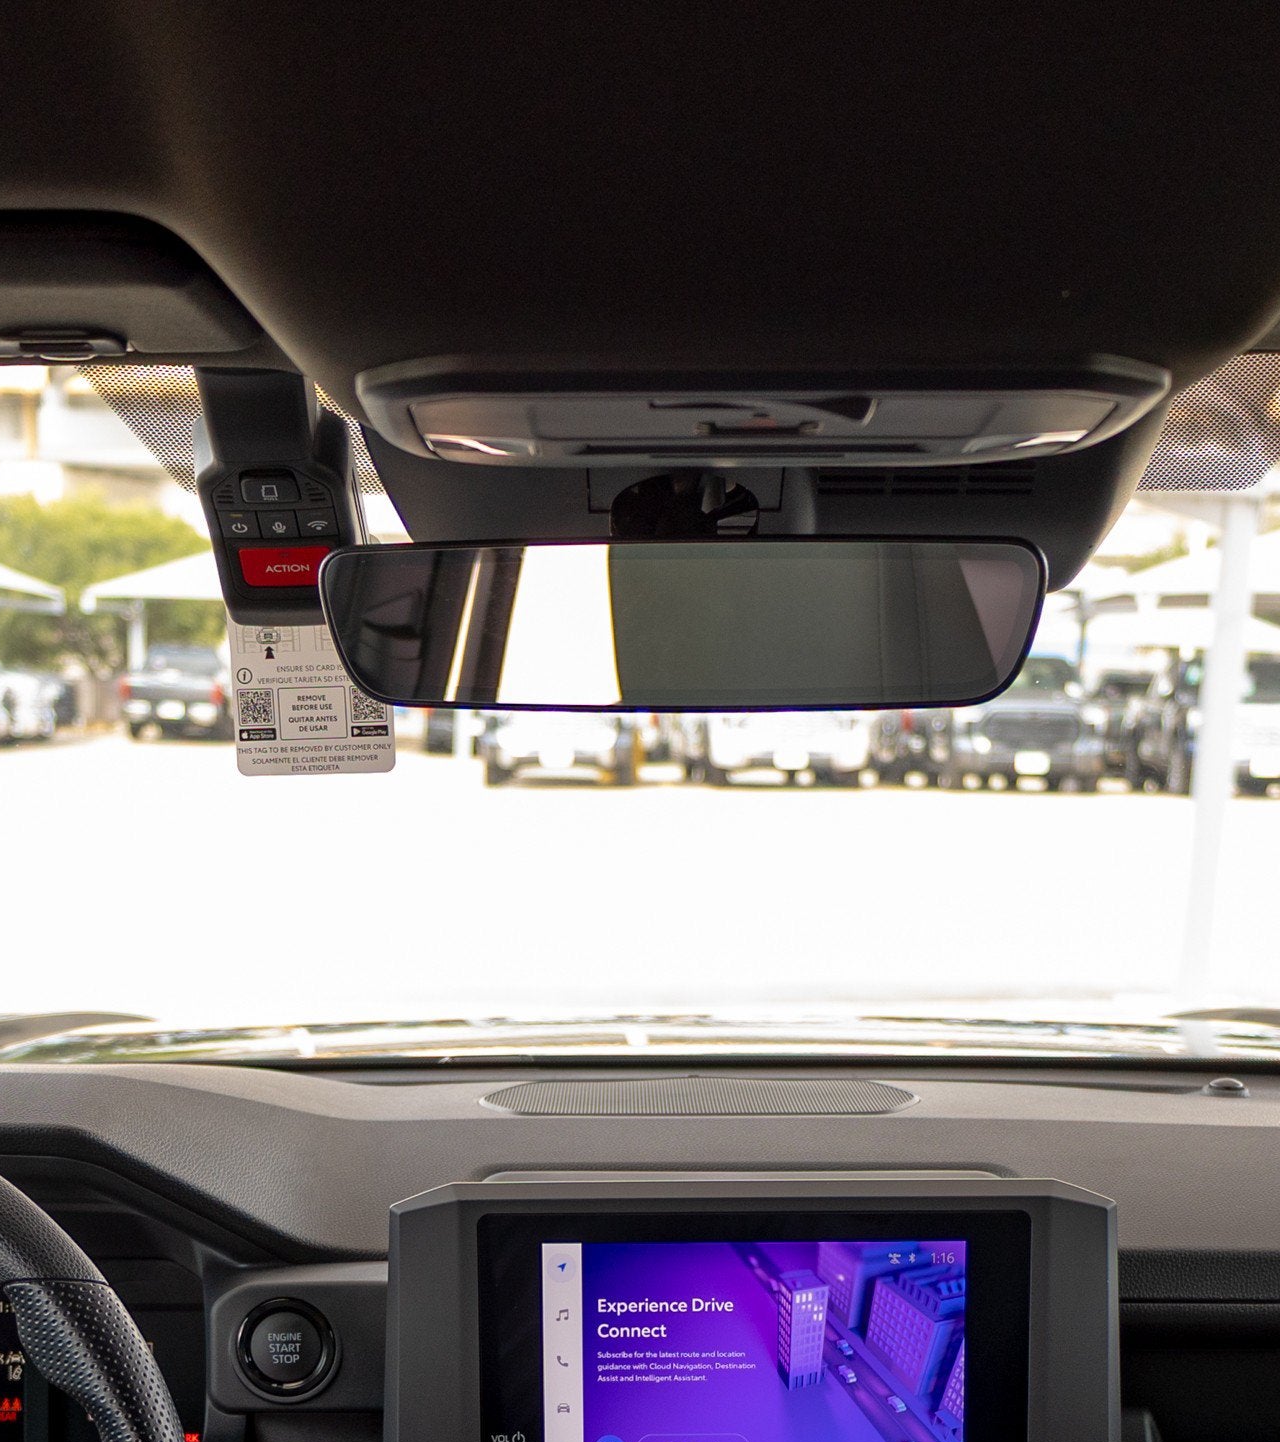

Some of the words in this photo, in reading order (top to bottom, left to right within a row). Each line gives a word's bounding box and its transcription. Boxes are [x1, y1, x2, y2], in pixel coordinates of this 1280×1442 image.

[265, 564, 310, 573] ACTION
[276, 665, 303, 673] ENSURE
[258, 677, 293, 685] VERIFIQUE
[294, 676, 323, 684] TARJETA
[296, 694, 326, 702] REMOVE
[288, 716, 315, 724] QUITAR
[290, 745, 323, 753] REMOVED
[335, 744, 372, 752] CUSTOMER
[252, 757, 291, 765] SOLAMENTE
[346, 754, 379, 762] REMOVER
[307, 764, 340, 772] ETIQUETA
[930, 1252, 955, 1264] 1:16
[597, 1298, 688, 1316] Experience
[691, 1297, 734, 1312] Drive
[597, 1323, 667, 1338] Connect
[267, 1332, 302, 1341] ENGINE
[269, 1343, 301, 1353] START
[272, 1354, 300, 1364] STOP
[597, 1350, 633, 1359] Subscribe
[633, 1350, 644, 1359] for
[645, 1350, 658, 1358] the
[659, 1350, 680, 1358] latest
[680, 1350, 700, 1358] route
[701, 1350, 716, 1358] and
[716, 1350, 746, 1358] location
[597, 1362, 631, 1372] guidance
[632, 1362, 648, 1371] with
[649, 1362, 672, 1370] Cloud
[672, 1362, 713, 1371] Navigation,
[715, 1362, 757, 1370] Destination
[597, 1374, 619, 1382] Assist
[619, 1374, 634, 1382] and
[635, 1374, 672, 1384] Intelligent
[673, 1374, 708, 1382] Assistant.
[490, 1434, 510, 1442] VOL
